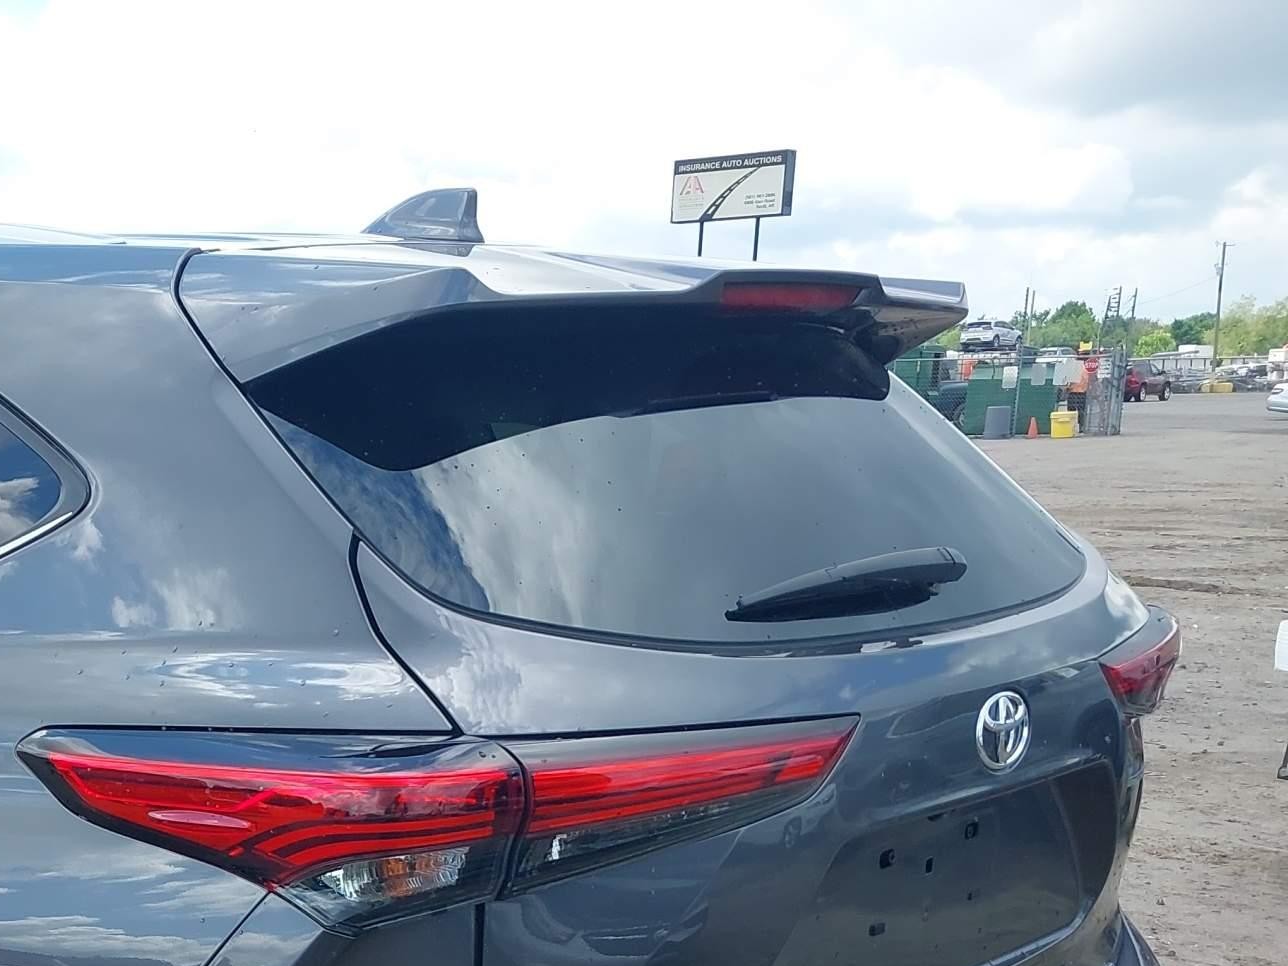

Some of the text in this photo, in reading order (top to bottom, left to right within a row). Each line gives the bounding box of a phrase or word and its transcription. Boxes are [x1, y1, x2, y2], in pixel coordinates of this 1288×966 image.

[678, 155, 782, 172] INSURANCE AUTO AUCTIONS
